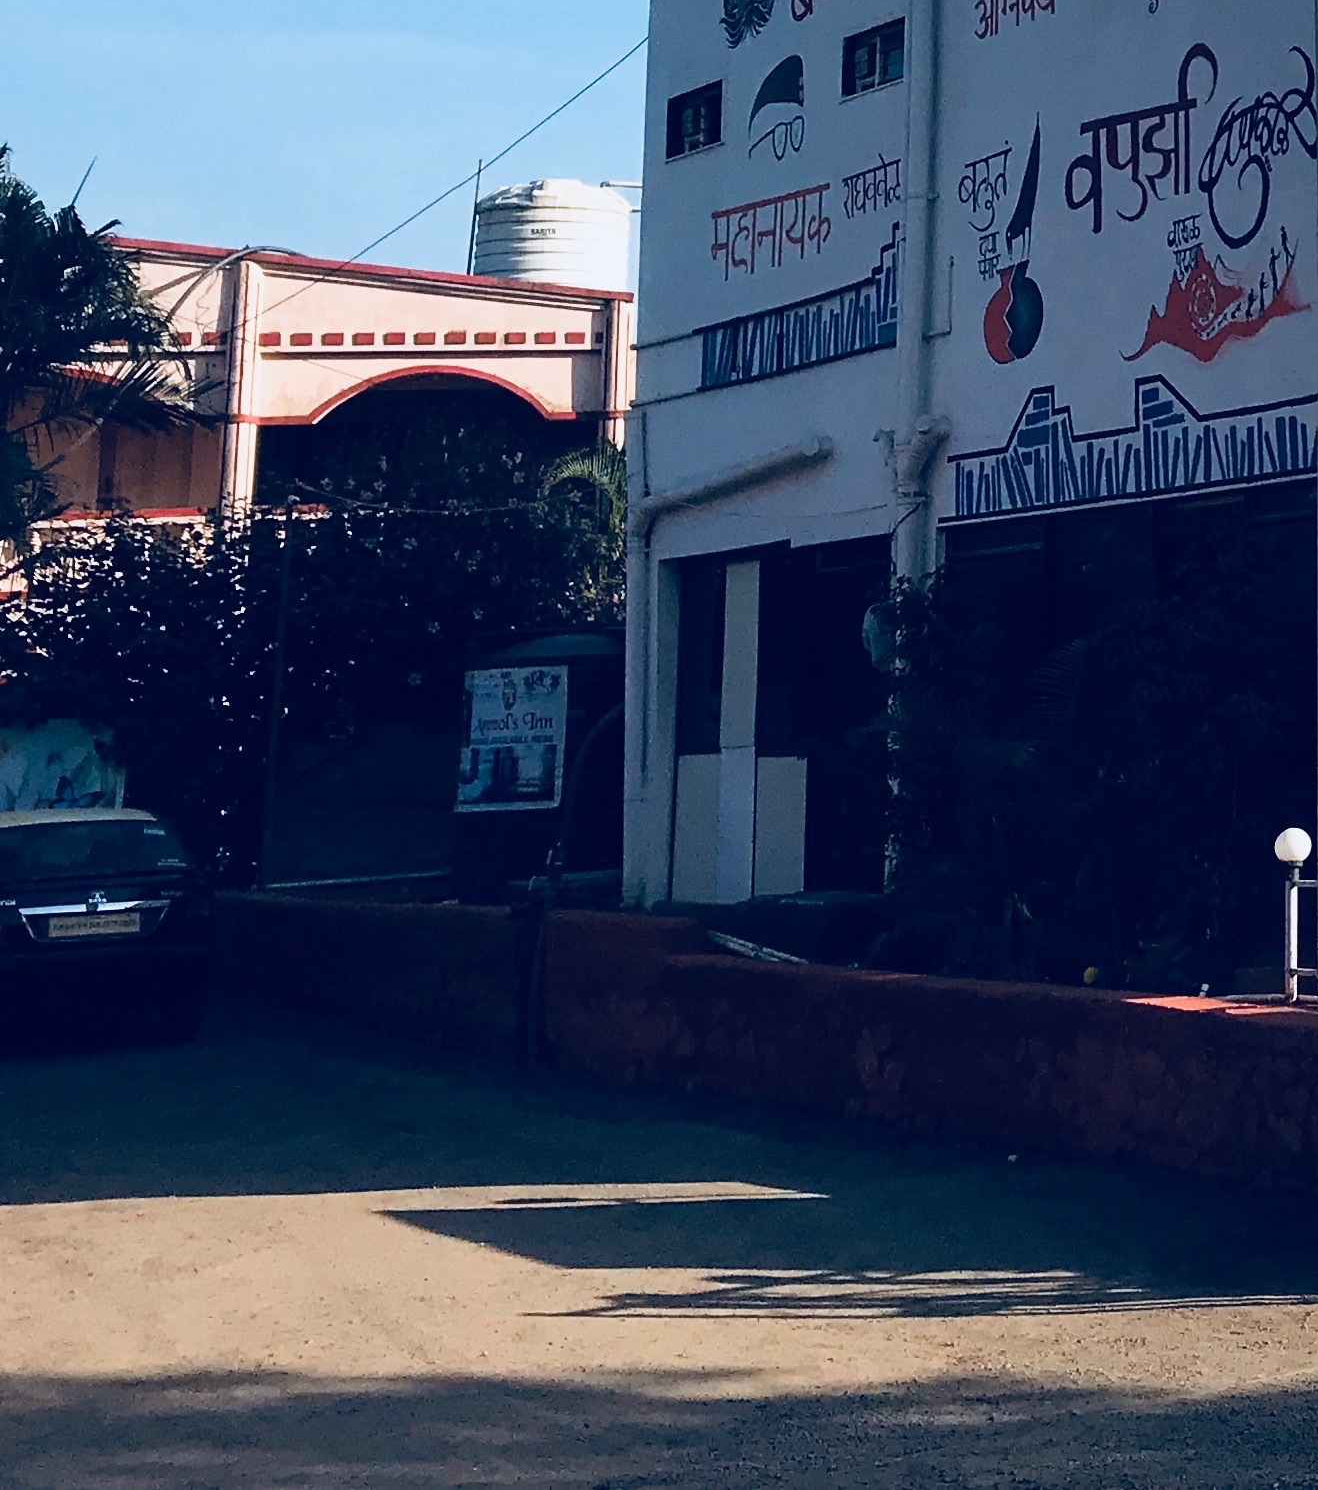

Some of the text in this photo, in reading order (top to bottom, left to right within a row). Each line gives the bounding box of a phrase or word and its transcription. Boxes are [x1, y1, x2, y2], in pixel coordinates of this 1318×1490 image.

[711, 182, 832, 281] महानायक
[958, 140, 1012, 232] बलुतं
[522, 712, 554, 730] Inn
